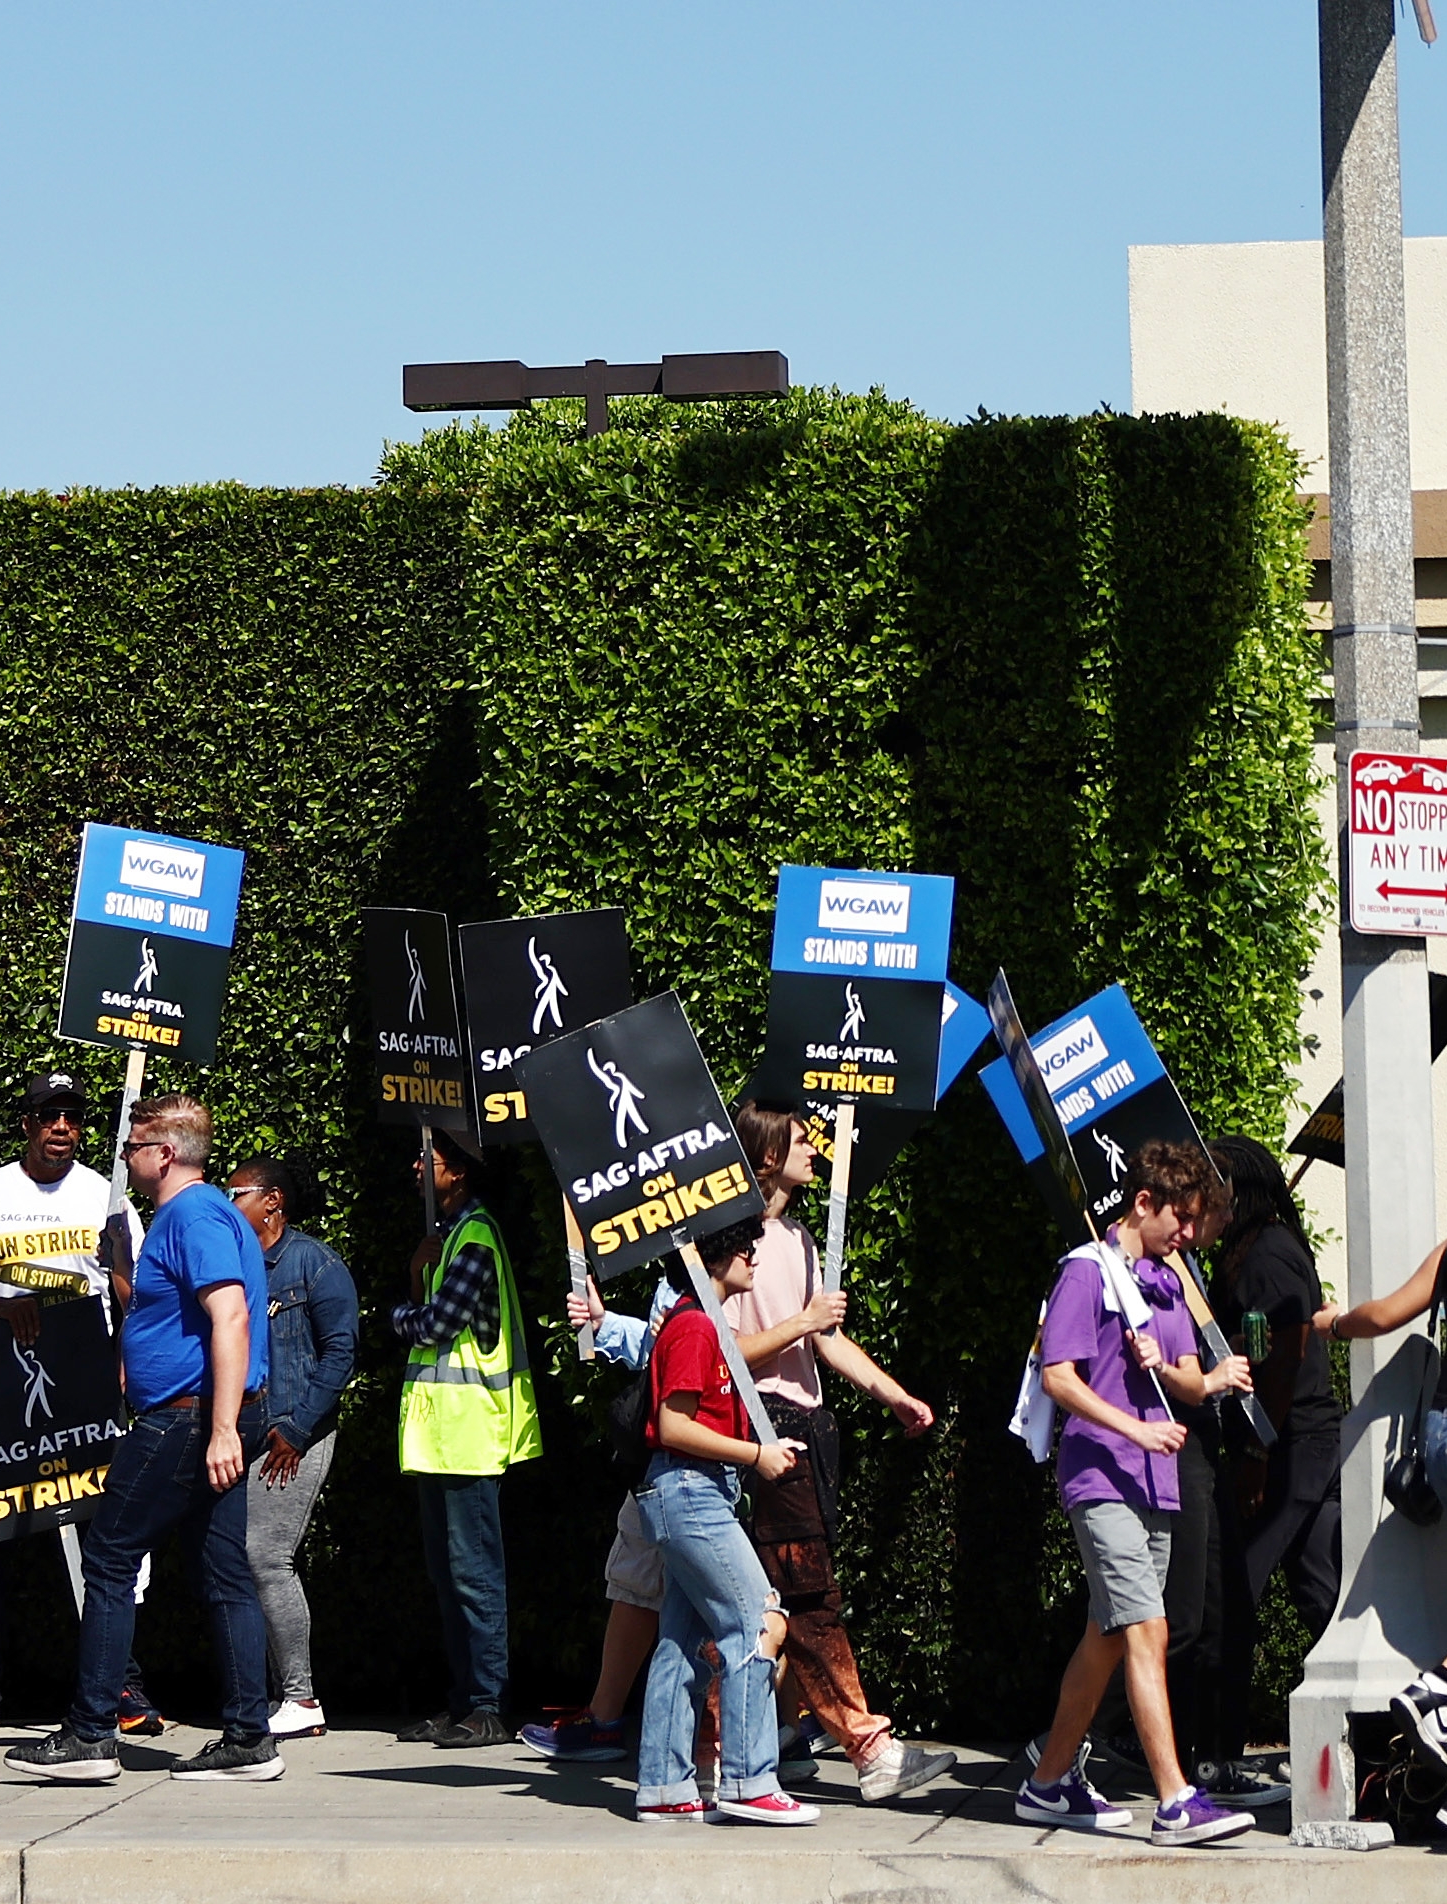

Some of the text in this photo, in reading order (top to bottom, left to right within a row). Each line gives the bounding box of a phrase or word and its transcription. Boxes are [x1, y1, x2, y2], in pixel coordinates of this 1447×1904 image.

[1354, 788, 1393, 832] NO
[127, 854, 200, 882] WGAW
[1370, 842, 1410, 871] ANY
[105, 891, 210, 933] STANDS WITH
[824, 895, 904, 916] WGAW
[1367, 904, 1391, 913] RECOVER
[803, 937, 918, 970] STANDS WITH
[131, 1011, 150, 1022] ON
[95, 1015, 182, 1047] STRIKE!
[413, 1059, 430, 1075] ON
[839, 1062, 859, 1073] ON
[381, 1073, 463, 1108] STRIKE!
[802, 1071, 895, 1095] STRIKE!
[1053, 1059, 1137, 1126] ANDS WITH
[809, 1114, 826, 1131] ON
[642, 1171, 676, 1197] ON
[589, 1161, 751, 1256] STRIKE!
[24, 1228, 92, 1256] STRIKE
[10, 1264, 28, 1282] ON
[28, 1267, 74, 1290] STRIKE
[38, 1457, 68, 1476] ON
